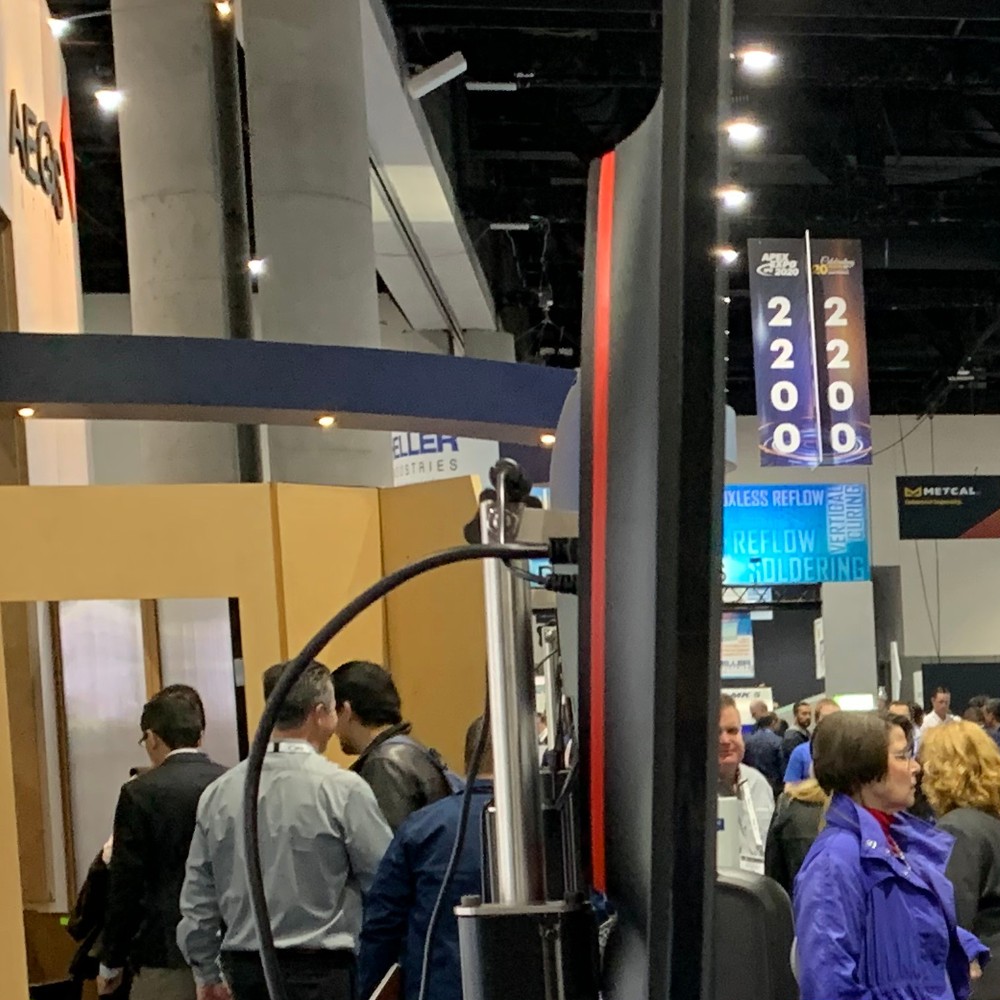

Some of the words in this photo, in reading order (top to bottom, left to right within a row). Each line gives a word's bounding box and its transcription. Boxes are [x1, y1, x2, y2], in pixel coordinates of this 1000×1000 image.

[772, 490, 824, 507] REFLOW
[923, 487, 976, 496] METCAL
[829, 486, 846, 554] VERTICAL
[733, 529, 815, 554] REFLOW
